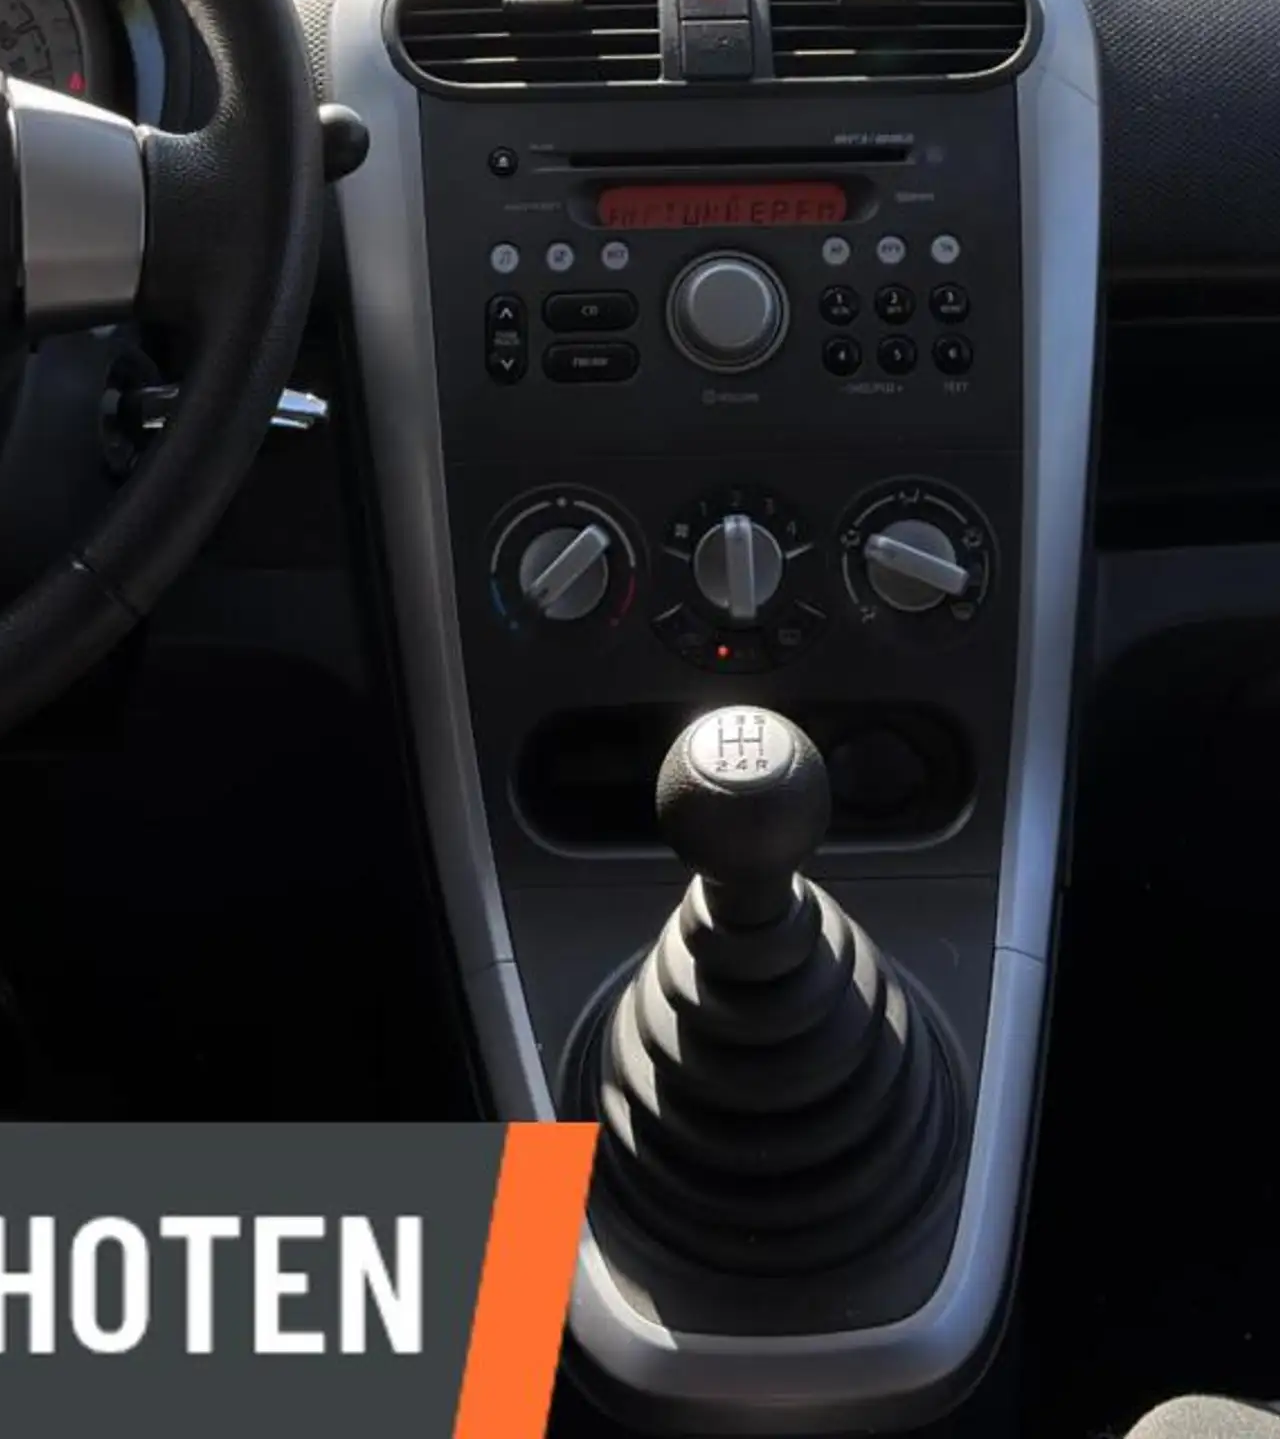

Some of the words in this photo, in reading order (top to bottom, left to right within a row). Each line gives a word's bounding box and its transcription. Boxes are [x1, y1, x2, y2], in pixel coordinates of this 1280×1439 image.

[714, 758, 730, 772] 2
[735, 758, 749, 772] 4
[754, 758, 769, 772] R
